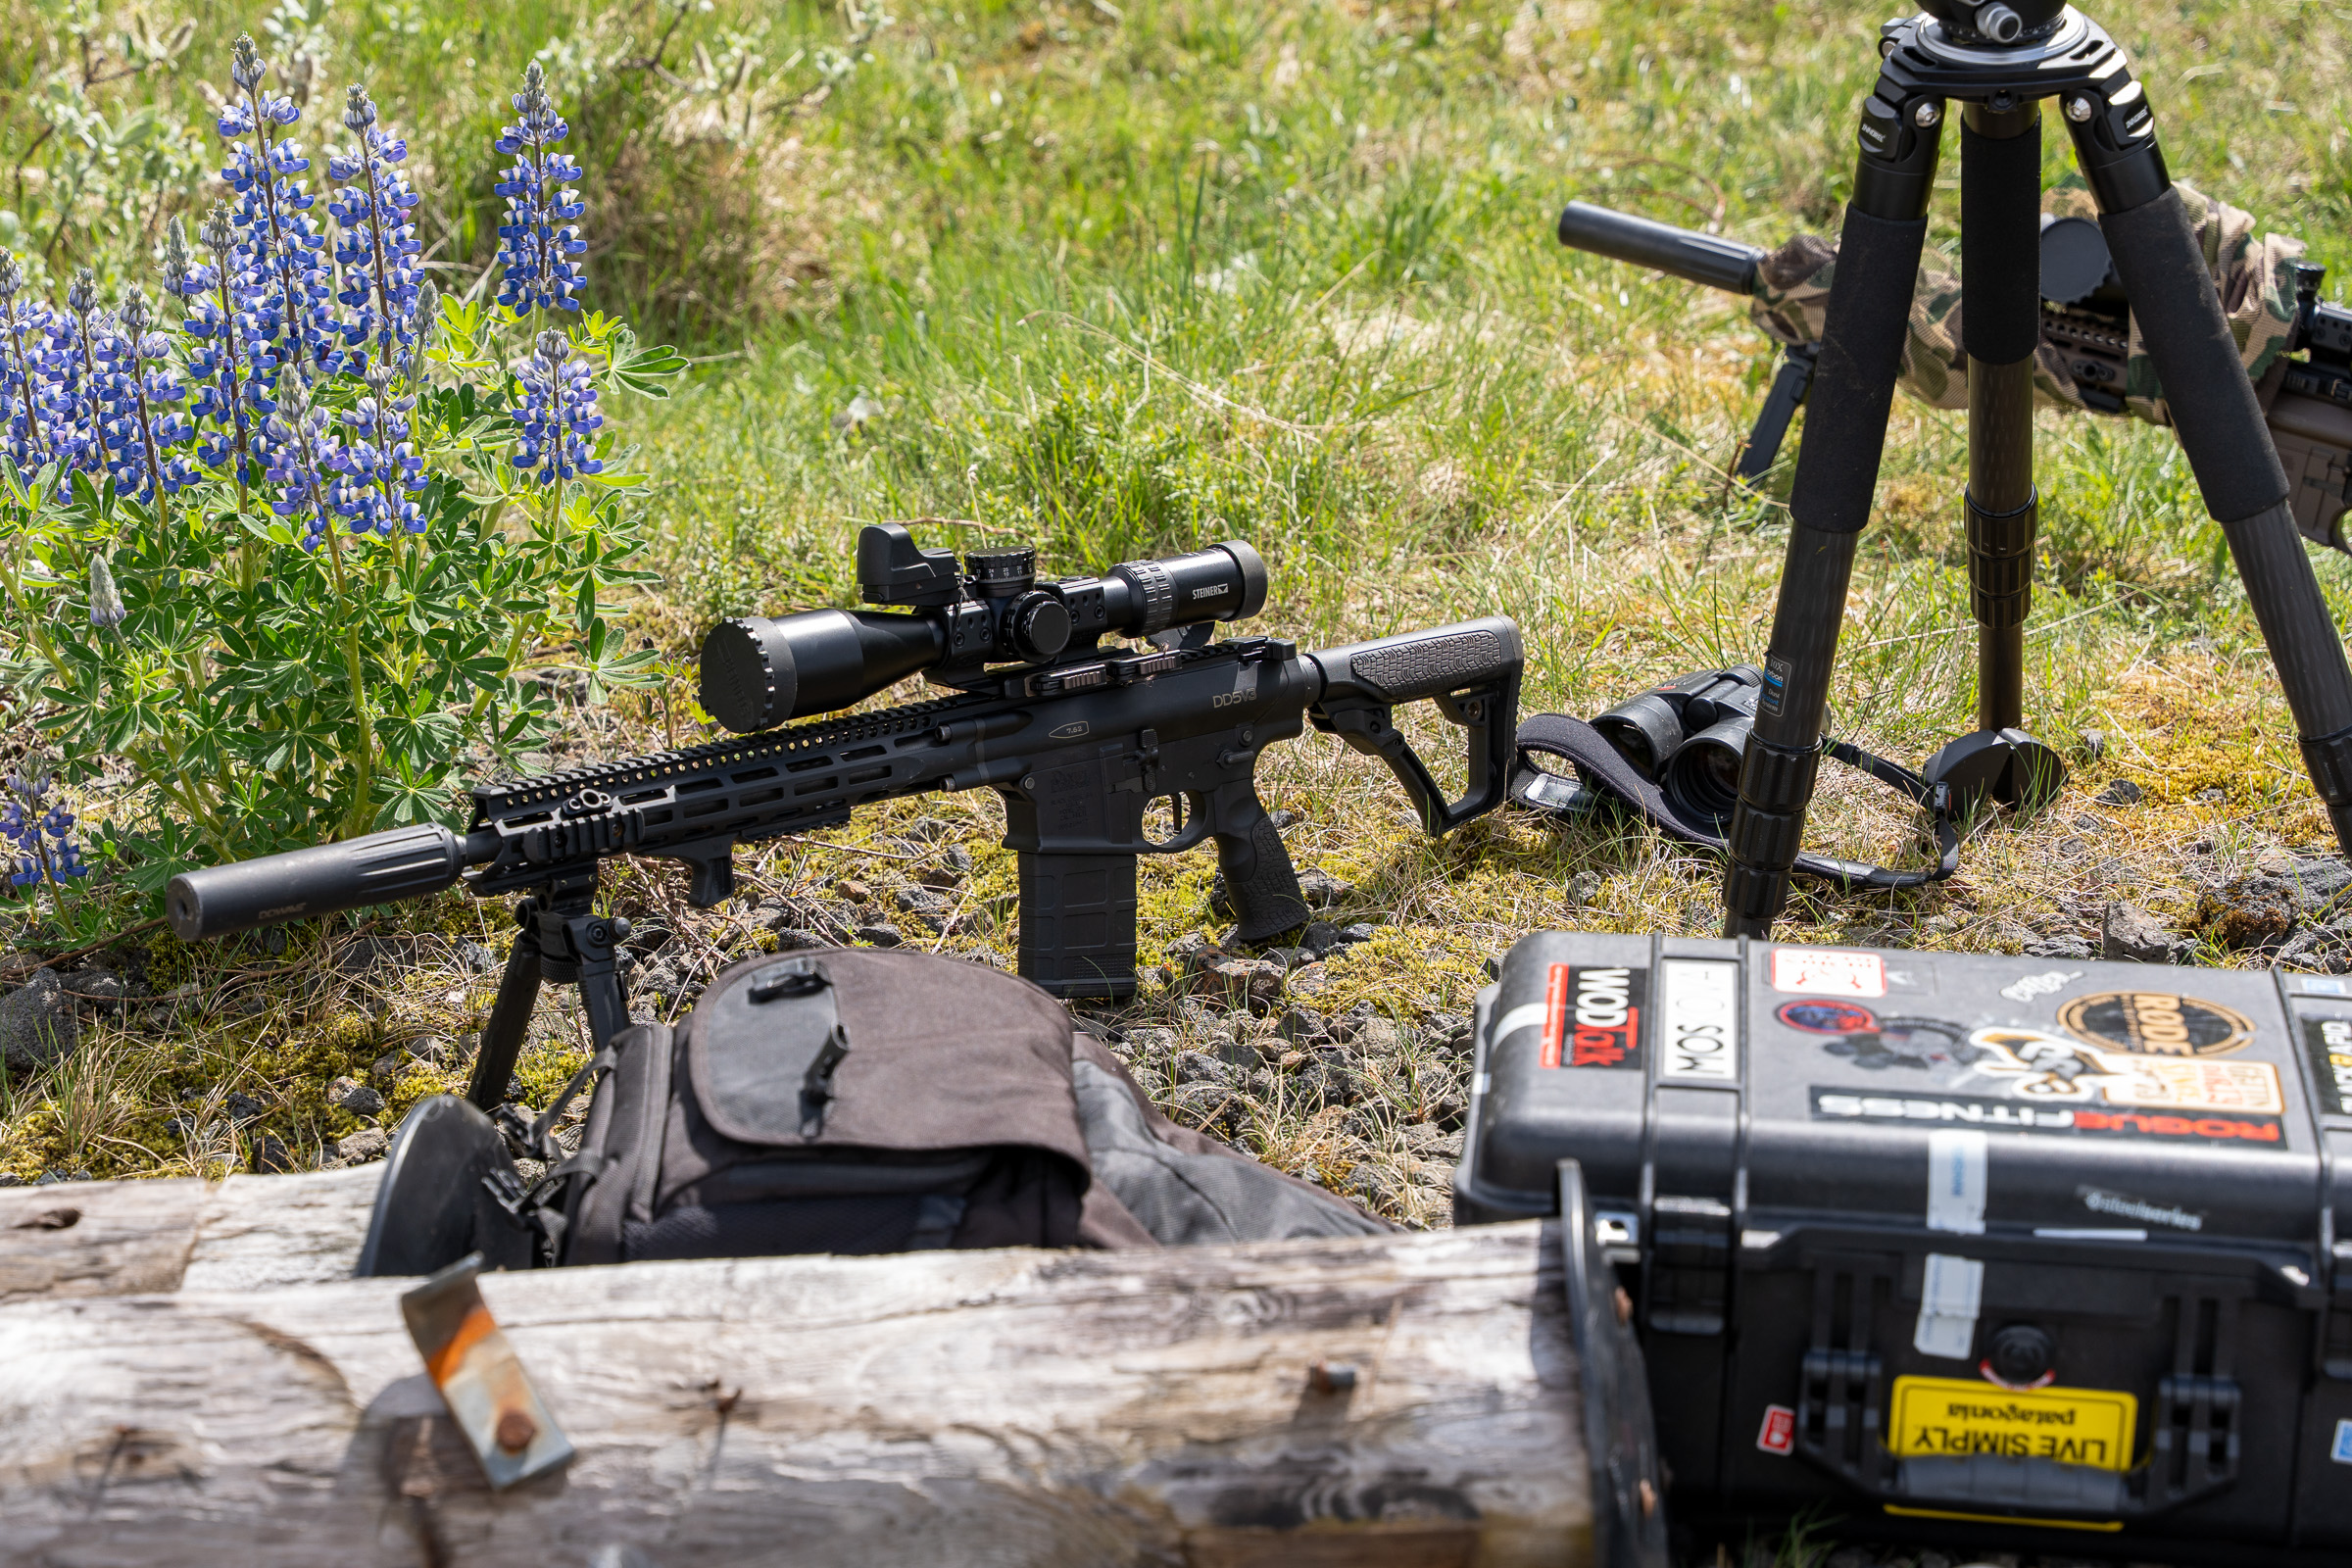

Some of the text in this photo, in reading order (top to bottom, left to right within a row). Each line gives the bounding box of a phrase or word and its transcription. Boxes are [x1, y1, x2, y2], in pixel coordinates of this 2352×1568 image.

[1192, 585, 1219, 600] STEINER
[1770, 659, 1784, 672] 10X
[1212, 687, 1257, 709] DD5V3
[1066, 725, 1083, 734] 7.62
[1946, 1402, 2078, 1426] patagonia
[1913, 1425, 2107, 1462] LIVE SIMPLY
